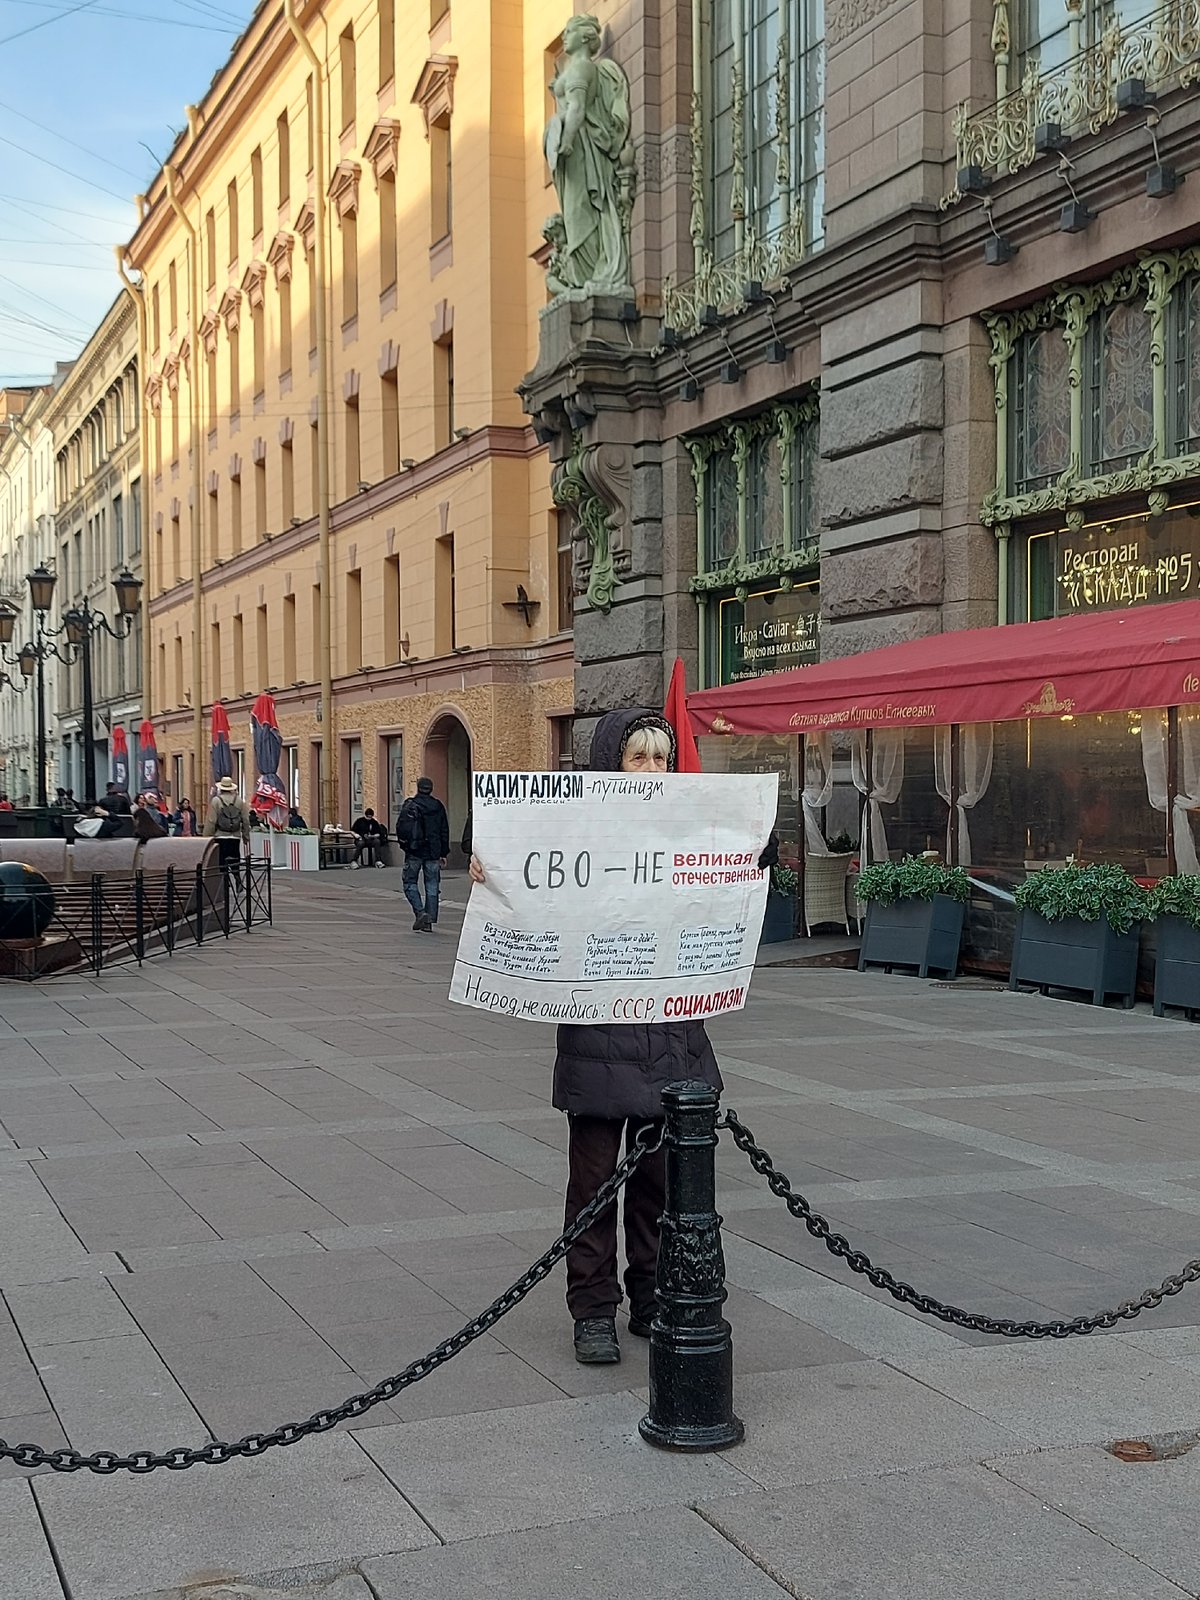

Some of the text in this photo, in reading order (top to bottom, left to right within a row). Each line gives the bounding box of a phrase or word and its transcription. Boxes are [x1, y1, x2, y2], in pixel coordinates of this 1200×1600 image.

[1064, 542, 1138, 573] Ресторан
[735, 625, 758, 646] Икра
[762, 619, 790, 638] Caviar
[743, 639, 817, 661] Вкусно на всех языках
[789, 703, 936, 727] Летняя веранда Купцов Елисеевых
[474, 773, 584, 799] КАПИТАЛИЗМ
[523, 850, 592, 890] СВО
[633, 851, 666, 885] НЕ
[673, 852, 753, 867] великая
[672, 868, 764, 885] отечественная
[663, 986, 745, 1019] СОЦИАЛИЗМ
